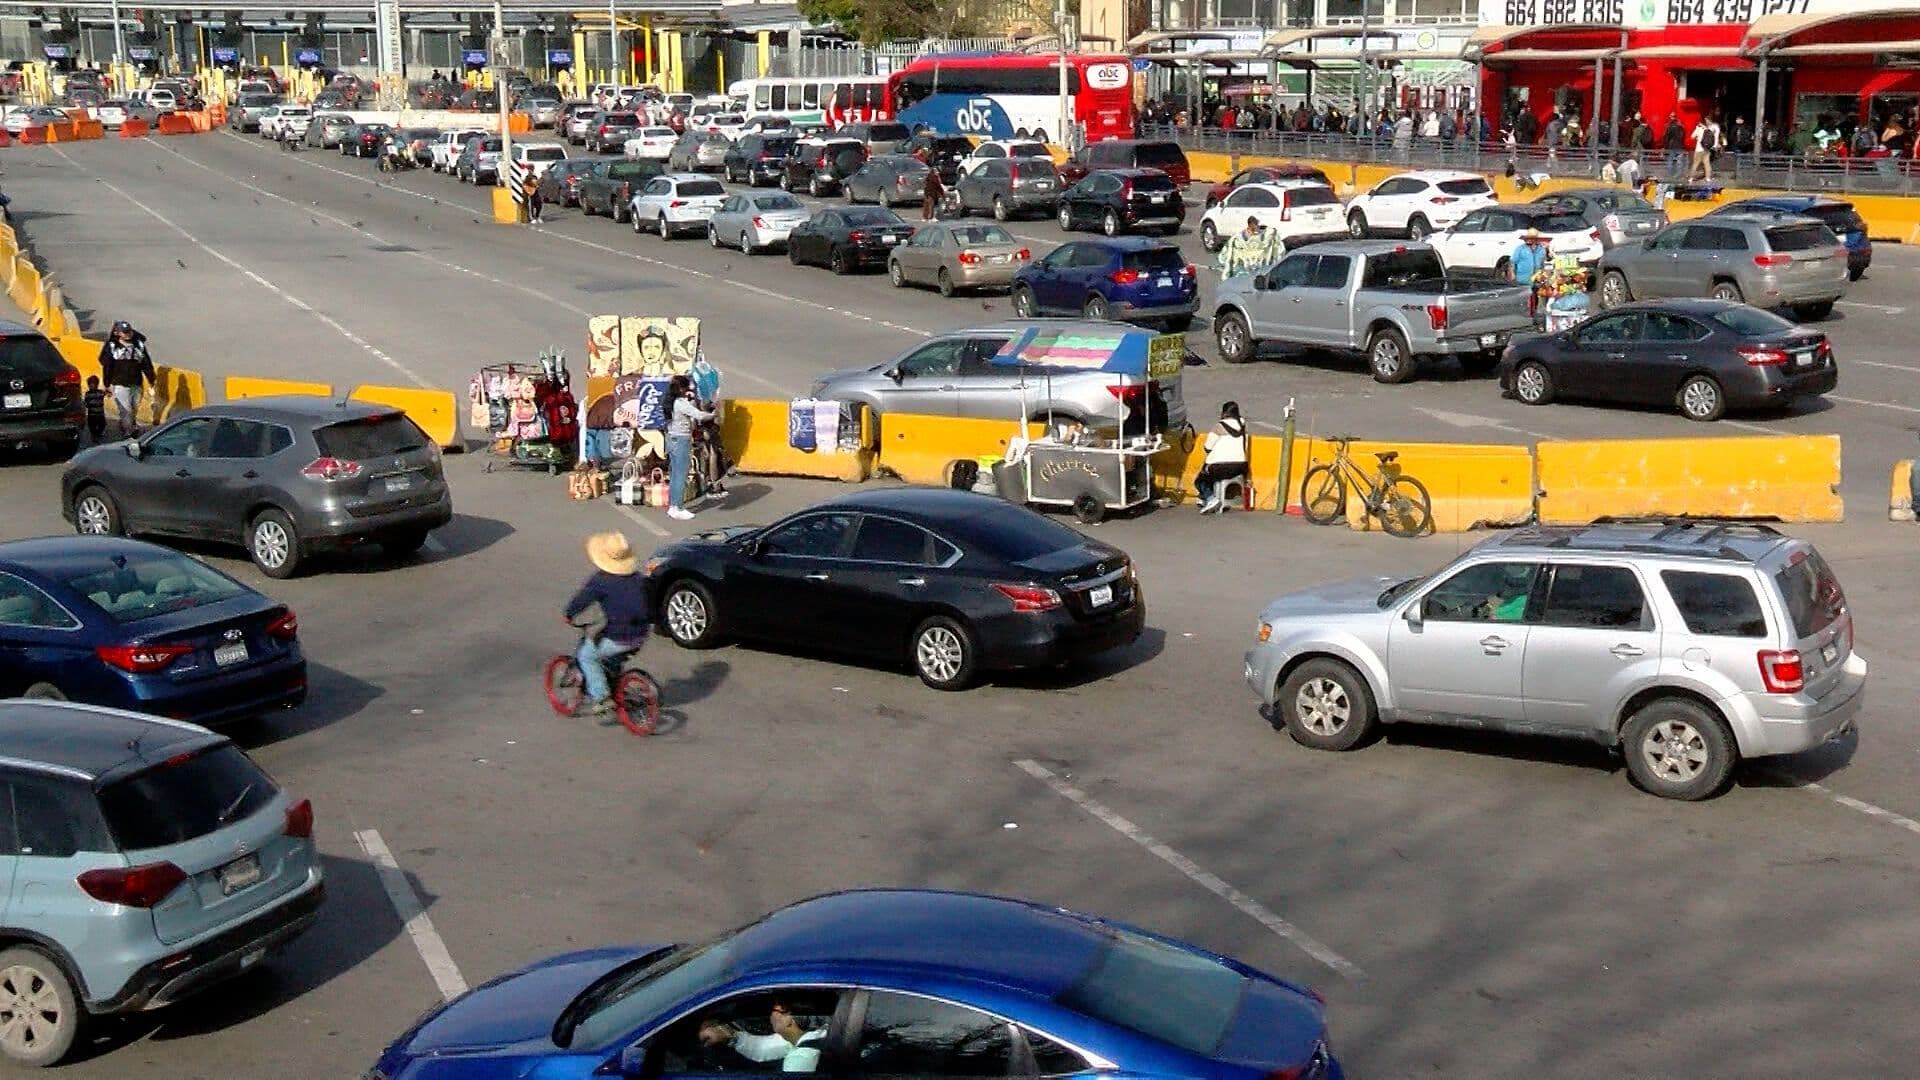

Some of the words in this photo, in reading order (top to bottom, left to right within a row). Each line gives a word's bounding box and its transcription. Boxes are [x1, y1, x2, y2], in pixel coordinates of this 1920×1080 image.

[1505, 0, 1537, 25] 664
[1543, 0, 1576, 24] 682
[1583, 0, 1624, 24] 8315
[1667, 0, 1704, 24] 664
[1713, 0, 1753, 23] 439
[1098, 67, 1119, 78] abc
[957, 99, 992, 131] abc
